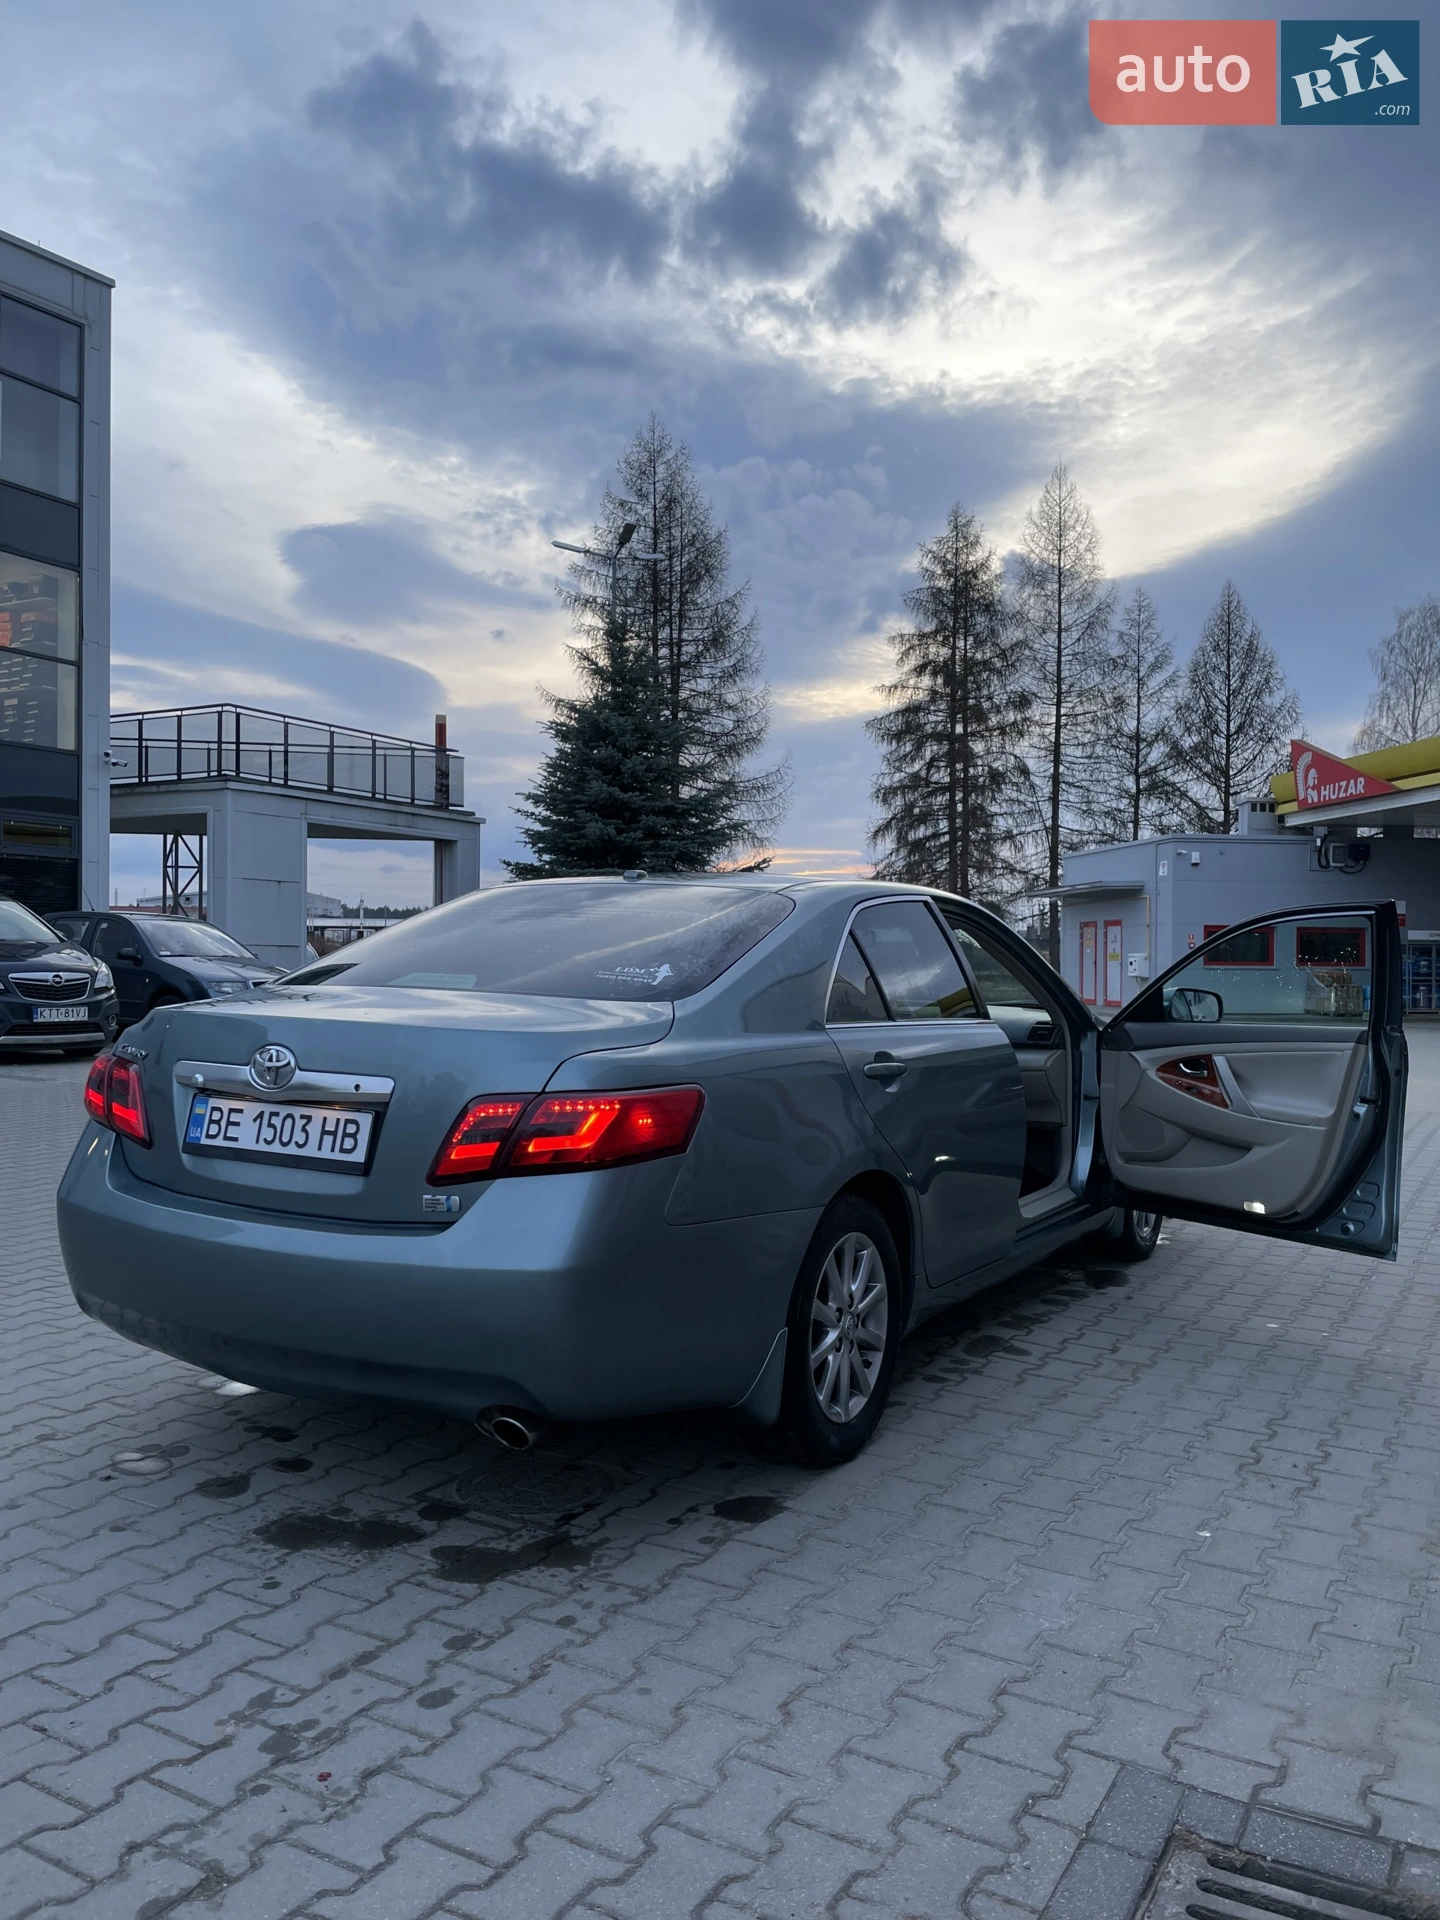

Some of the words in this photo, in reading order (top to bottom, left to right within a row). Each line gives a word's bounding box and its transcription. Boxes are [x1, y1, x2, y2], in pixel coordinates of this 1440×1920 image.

[1320, 777, 1365, 801] HUZAR
[39, 1008, 60, 1019] KTT
[190, 1127, 200, 1138] UA
[205, 1106, 244, 1142] BE
[252, 1110, 313, 1149] 1503
[317, 1116, 360, 1154] HB
